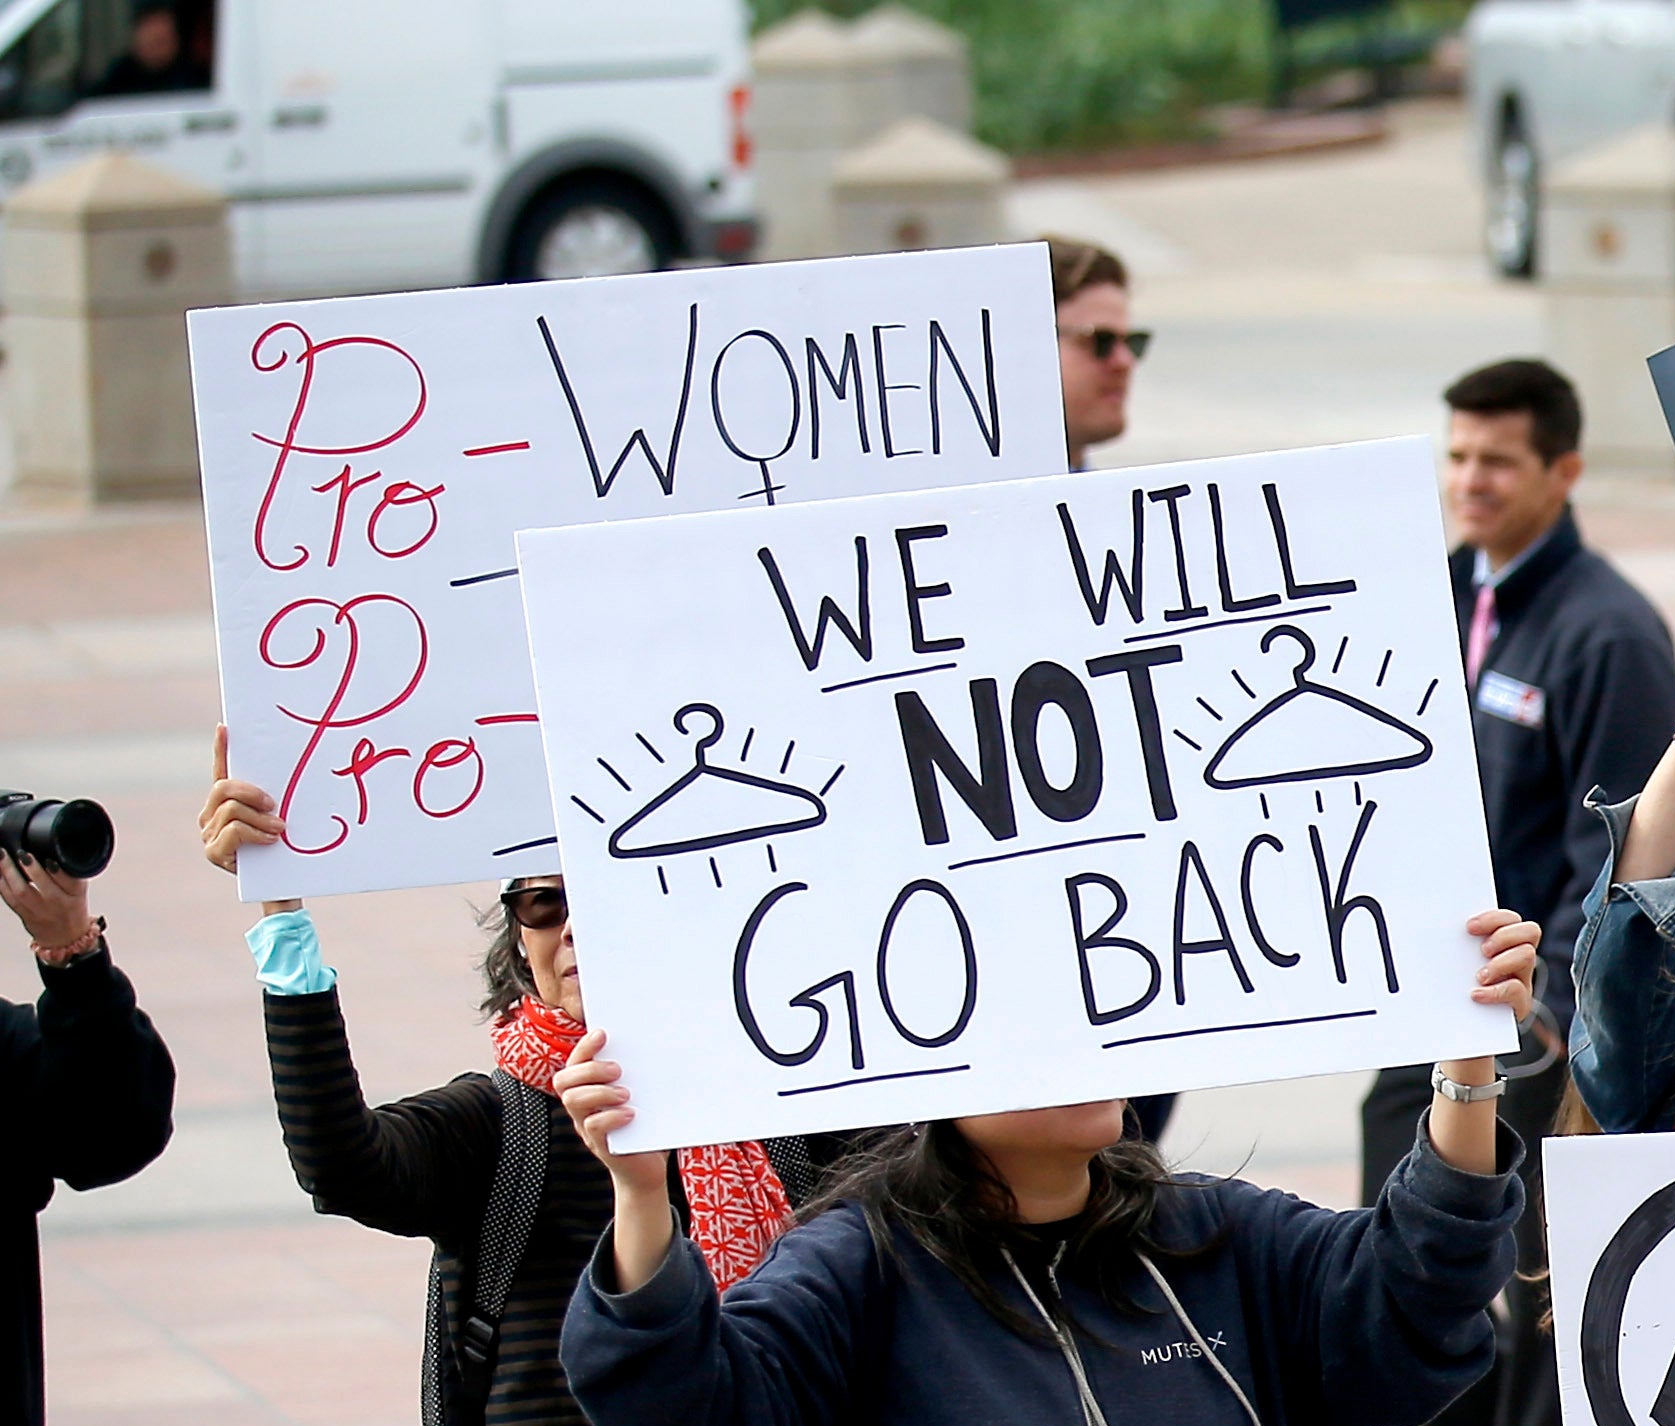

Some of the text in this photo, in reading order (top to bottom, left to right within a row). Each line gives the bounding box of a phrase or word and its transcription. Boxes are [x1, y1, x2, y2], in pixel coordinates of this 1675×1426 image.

[537, 304, 1000, 503] WOMEN
[757, 482, 1356, 672] WE WILL
[894, 643, 1182, 846] NOT
[733, 799, 1399, 1069] GO BACK
[1140, 1330, 1228, 1366] MUTESX
